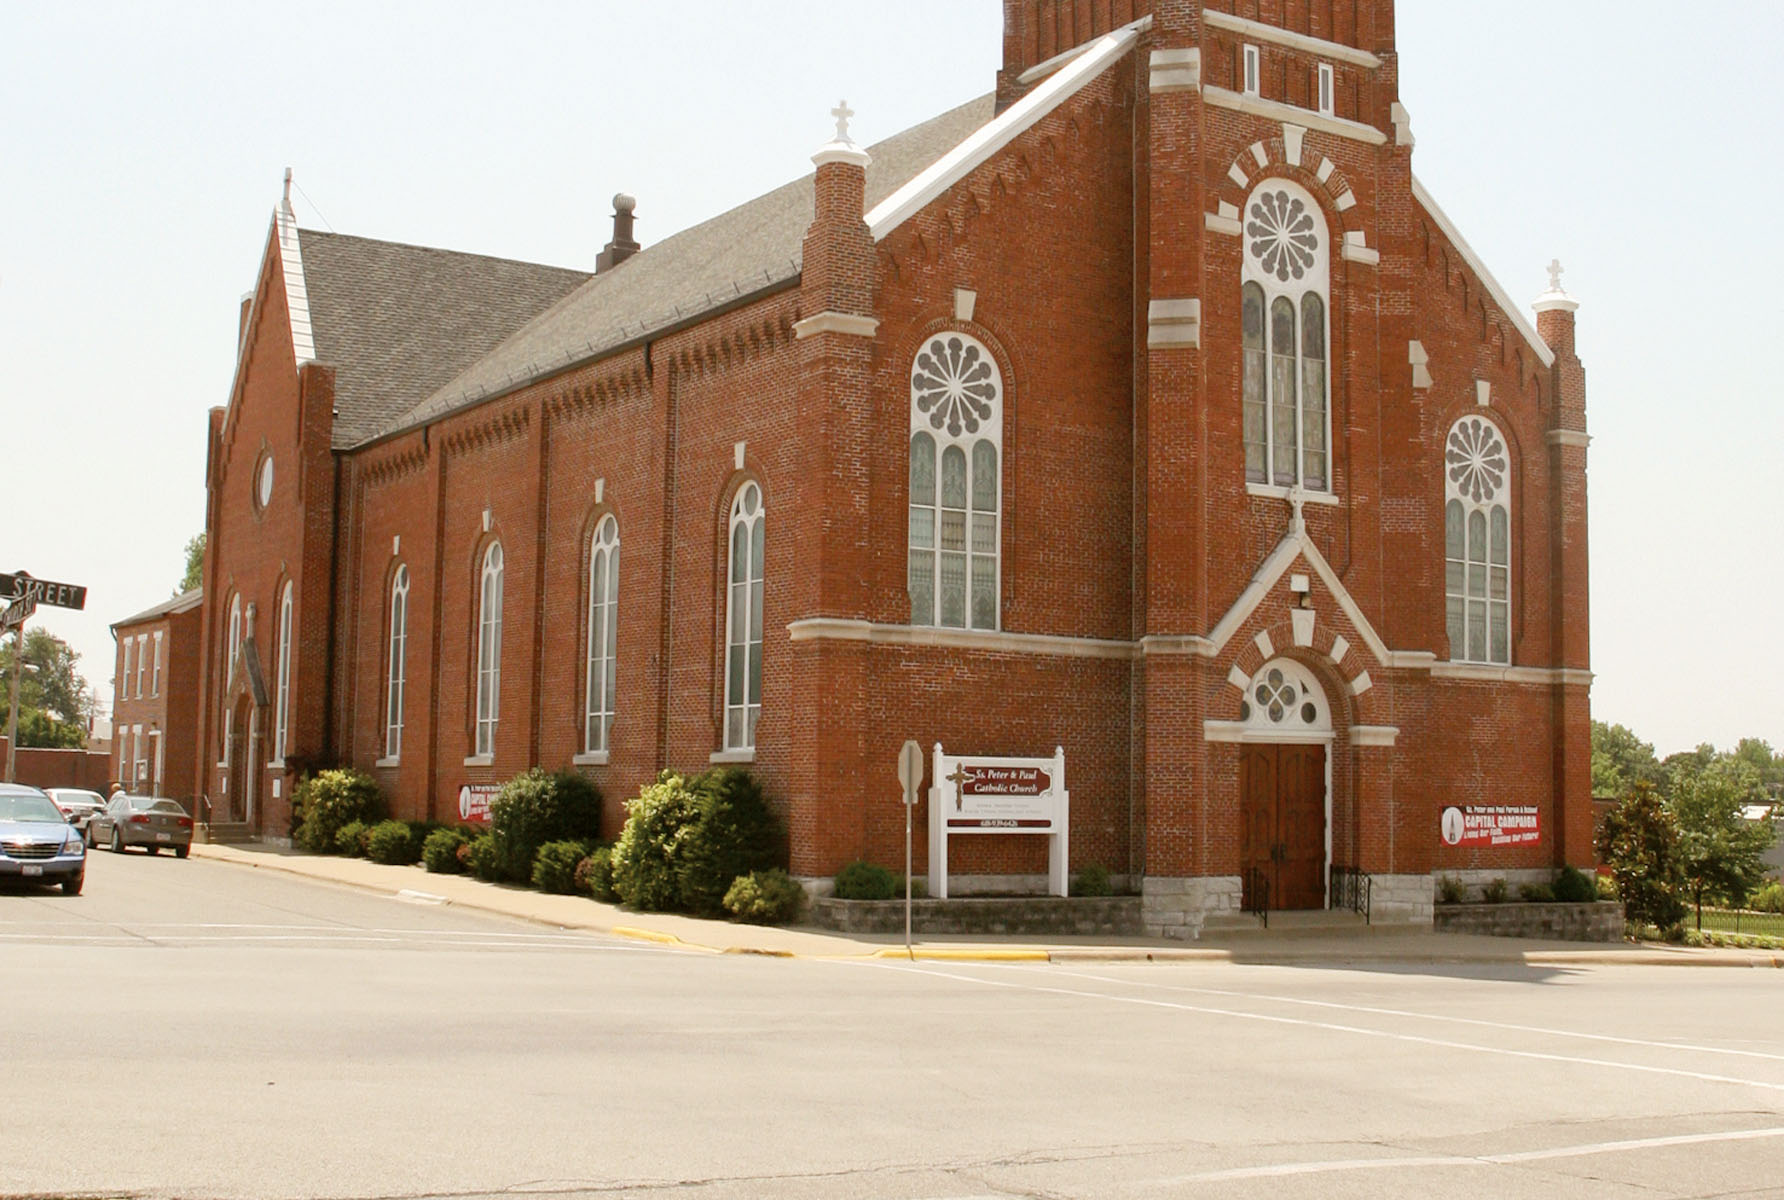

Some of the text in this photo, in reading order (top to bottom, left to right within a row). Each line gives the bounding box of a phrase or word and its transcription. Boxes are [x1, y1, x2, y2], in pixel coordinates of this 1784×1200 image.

[13, 578, 77, 607] STREET
[987, 769, 1008, 779] Peter
[1010, 770, 1017, 779] &
[1019, 770, 1037, 779] Paul
[974, 783, 1038, 793] Catholic Church
[1465, 815, 1537, 828] CAPITAL CAMPAIGN
